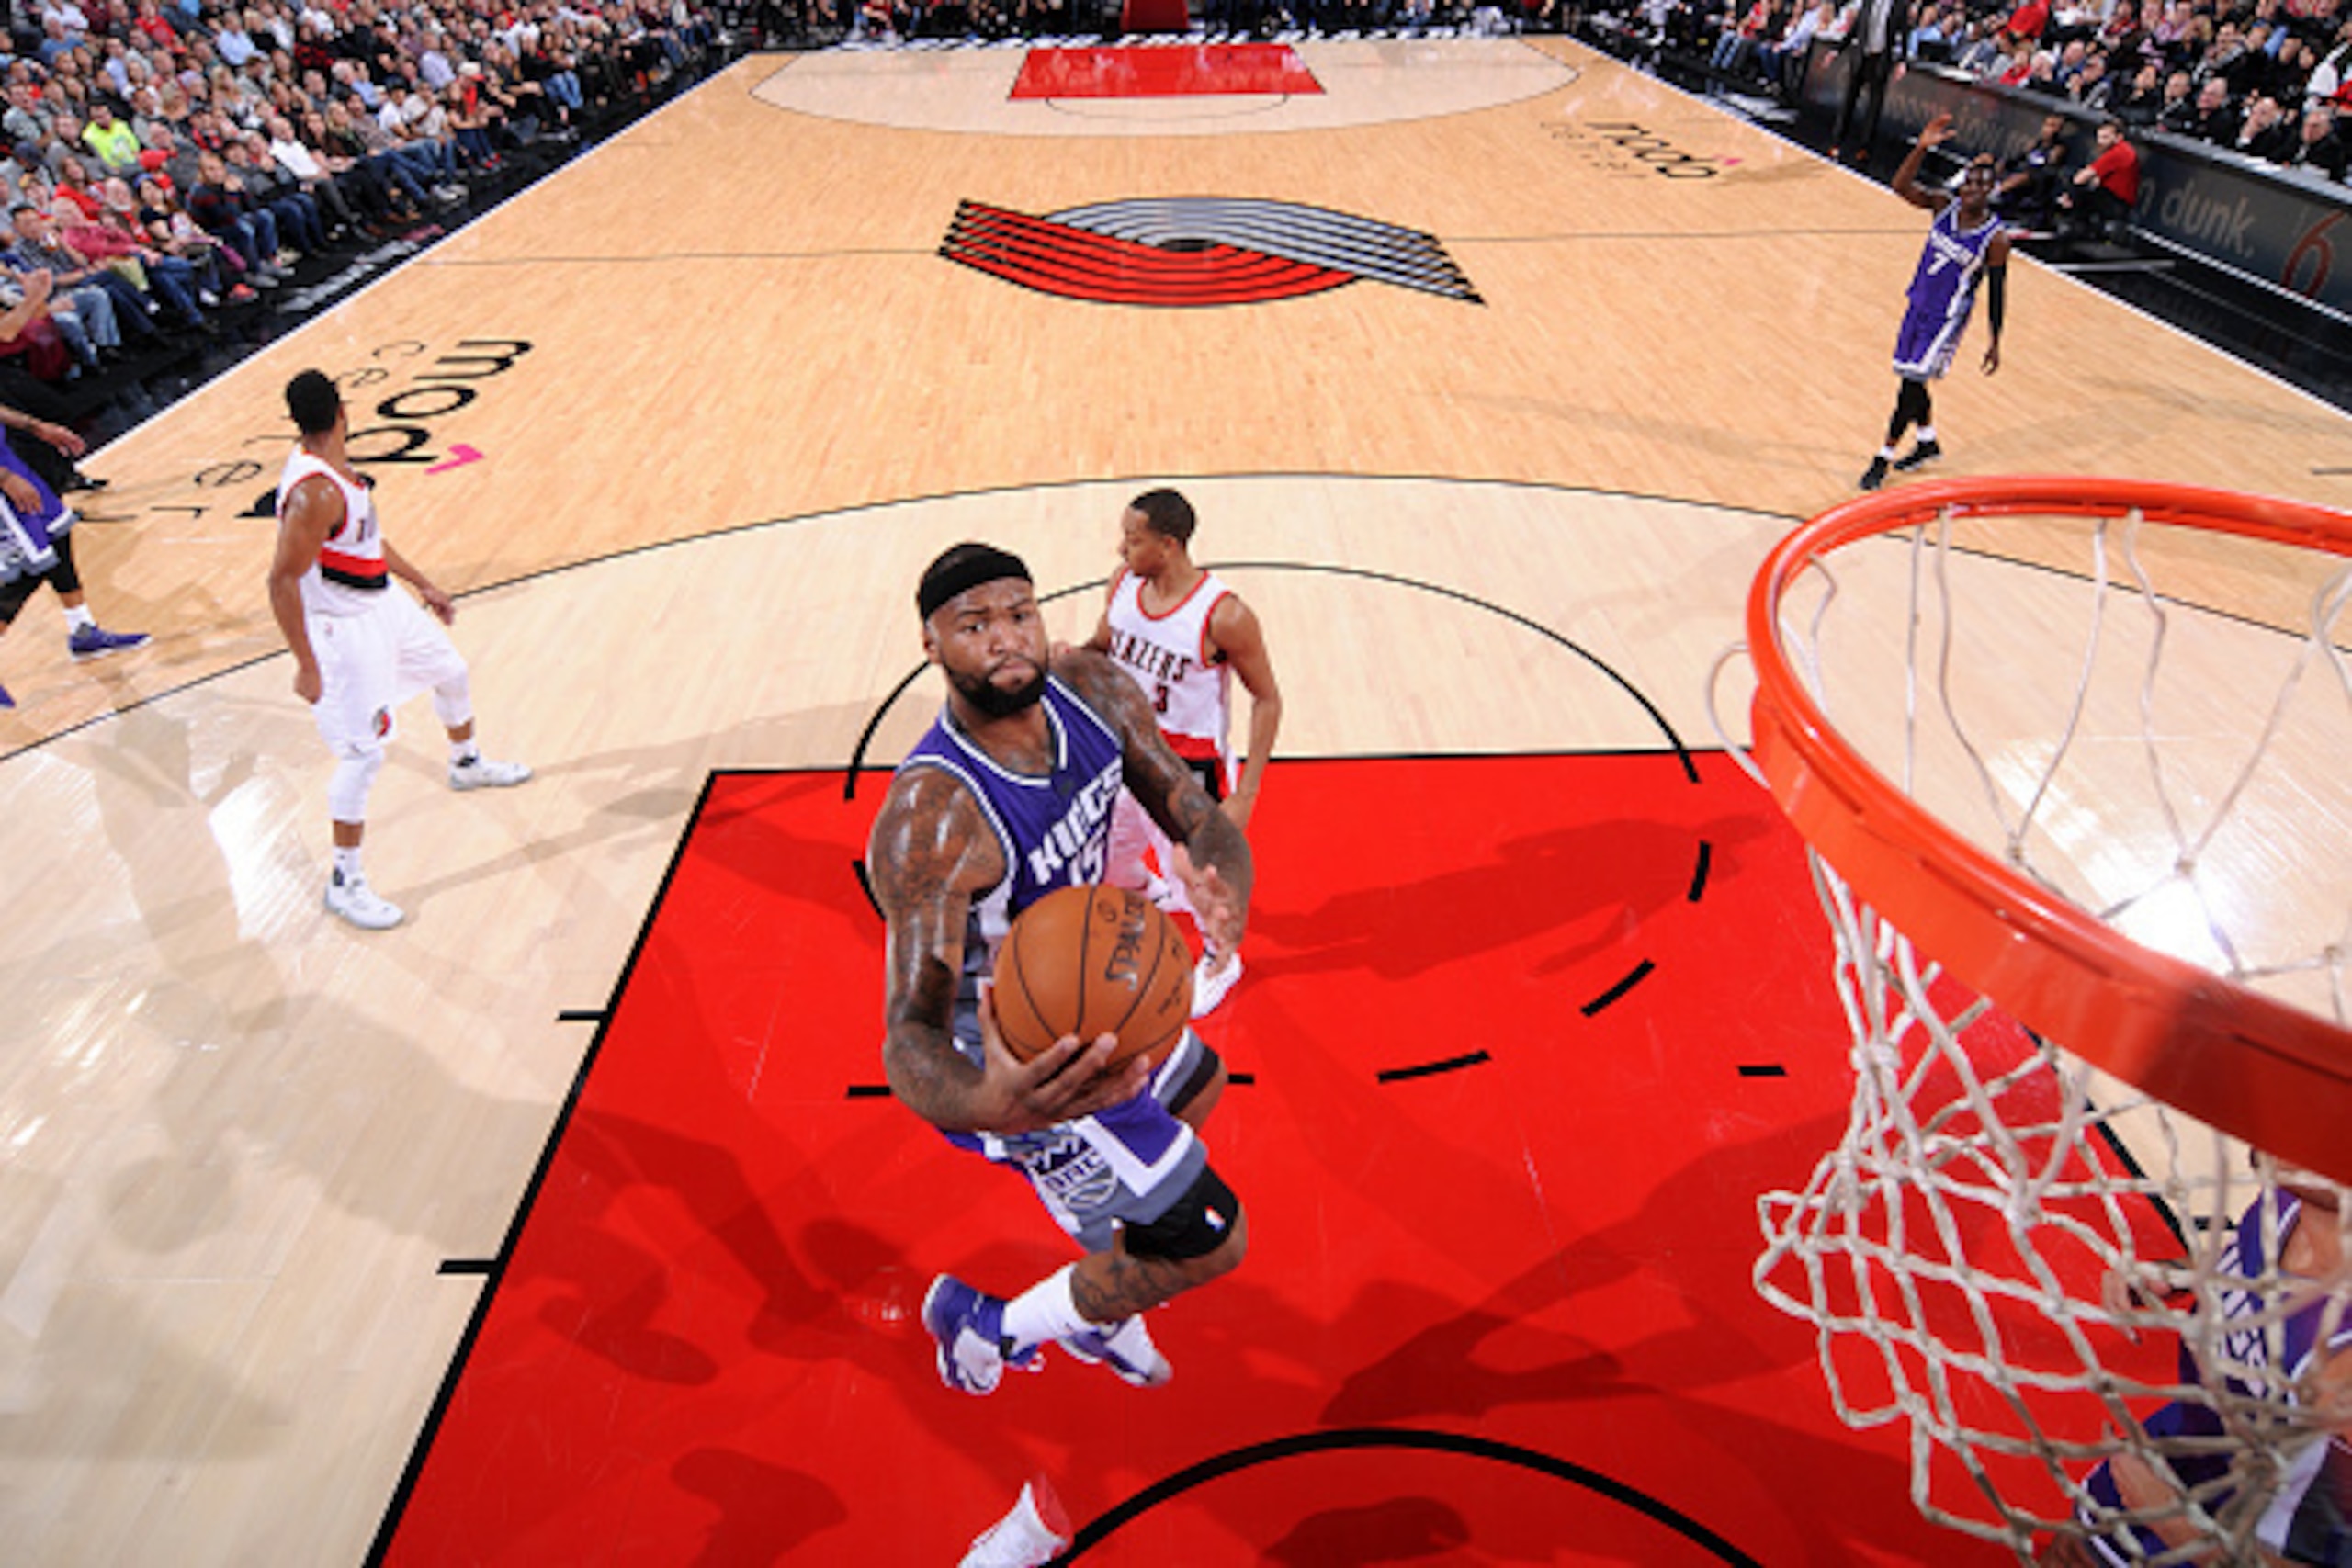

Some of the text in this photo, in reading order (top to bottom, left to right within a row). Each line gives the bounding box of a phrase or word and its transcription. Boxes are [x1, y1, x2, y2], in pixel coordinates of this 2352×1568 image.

[2160, 177, 2256, 259] dunk.
[1927, 252, 1949, 276] 7
[1108, 626, 1192, 682] LAZERS
[1027, 755, 1123, 886] KINGS
